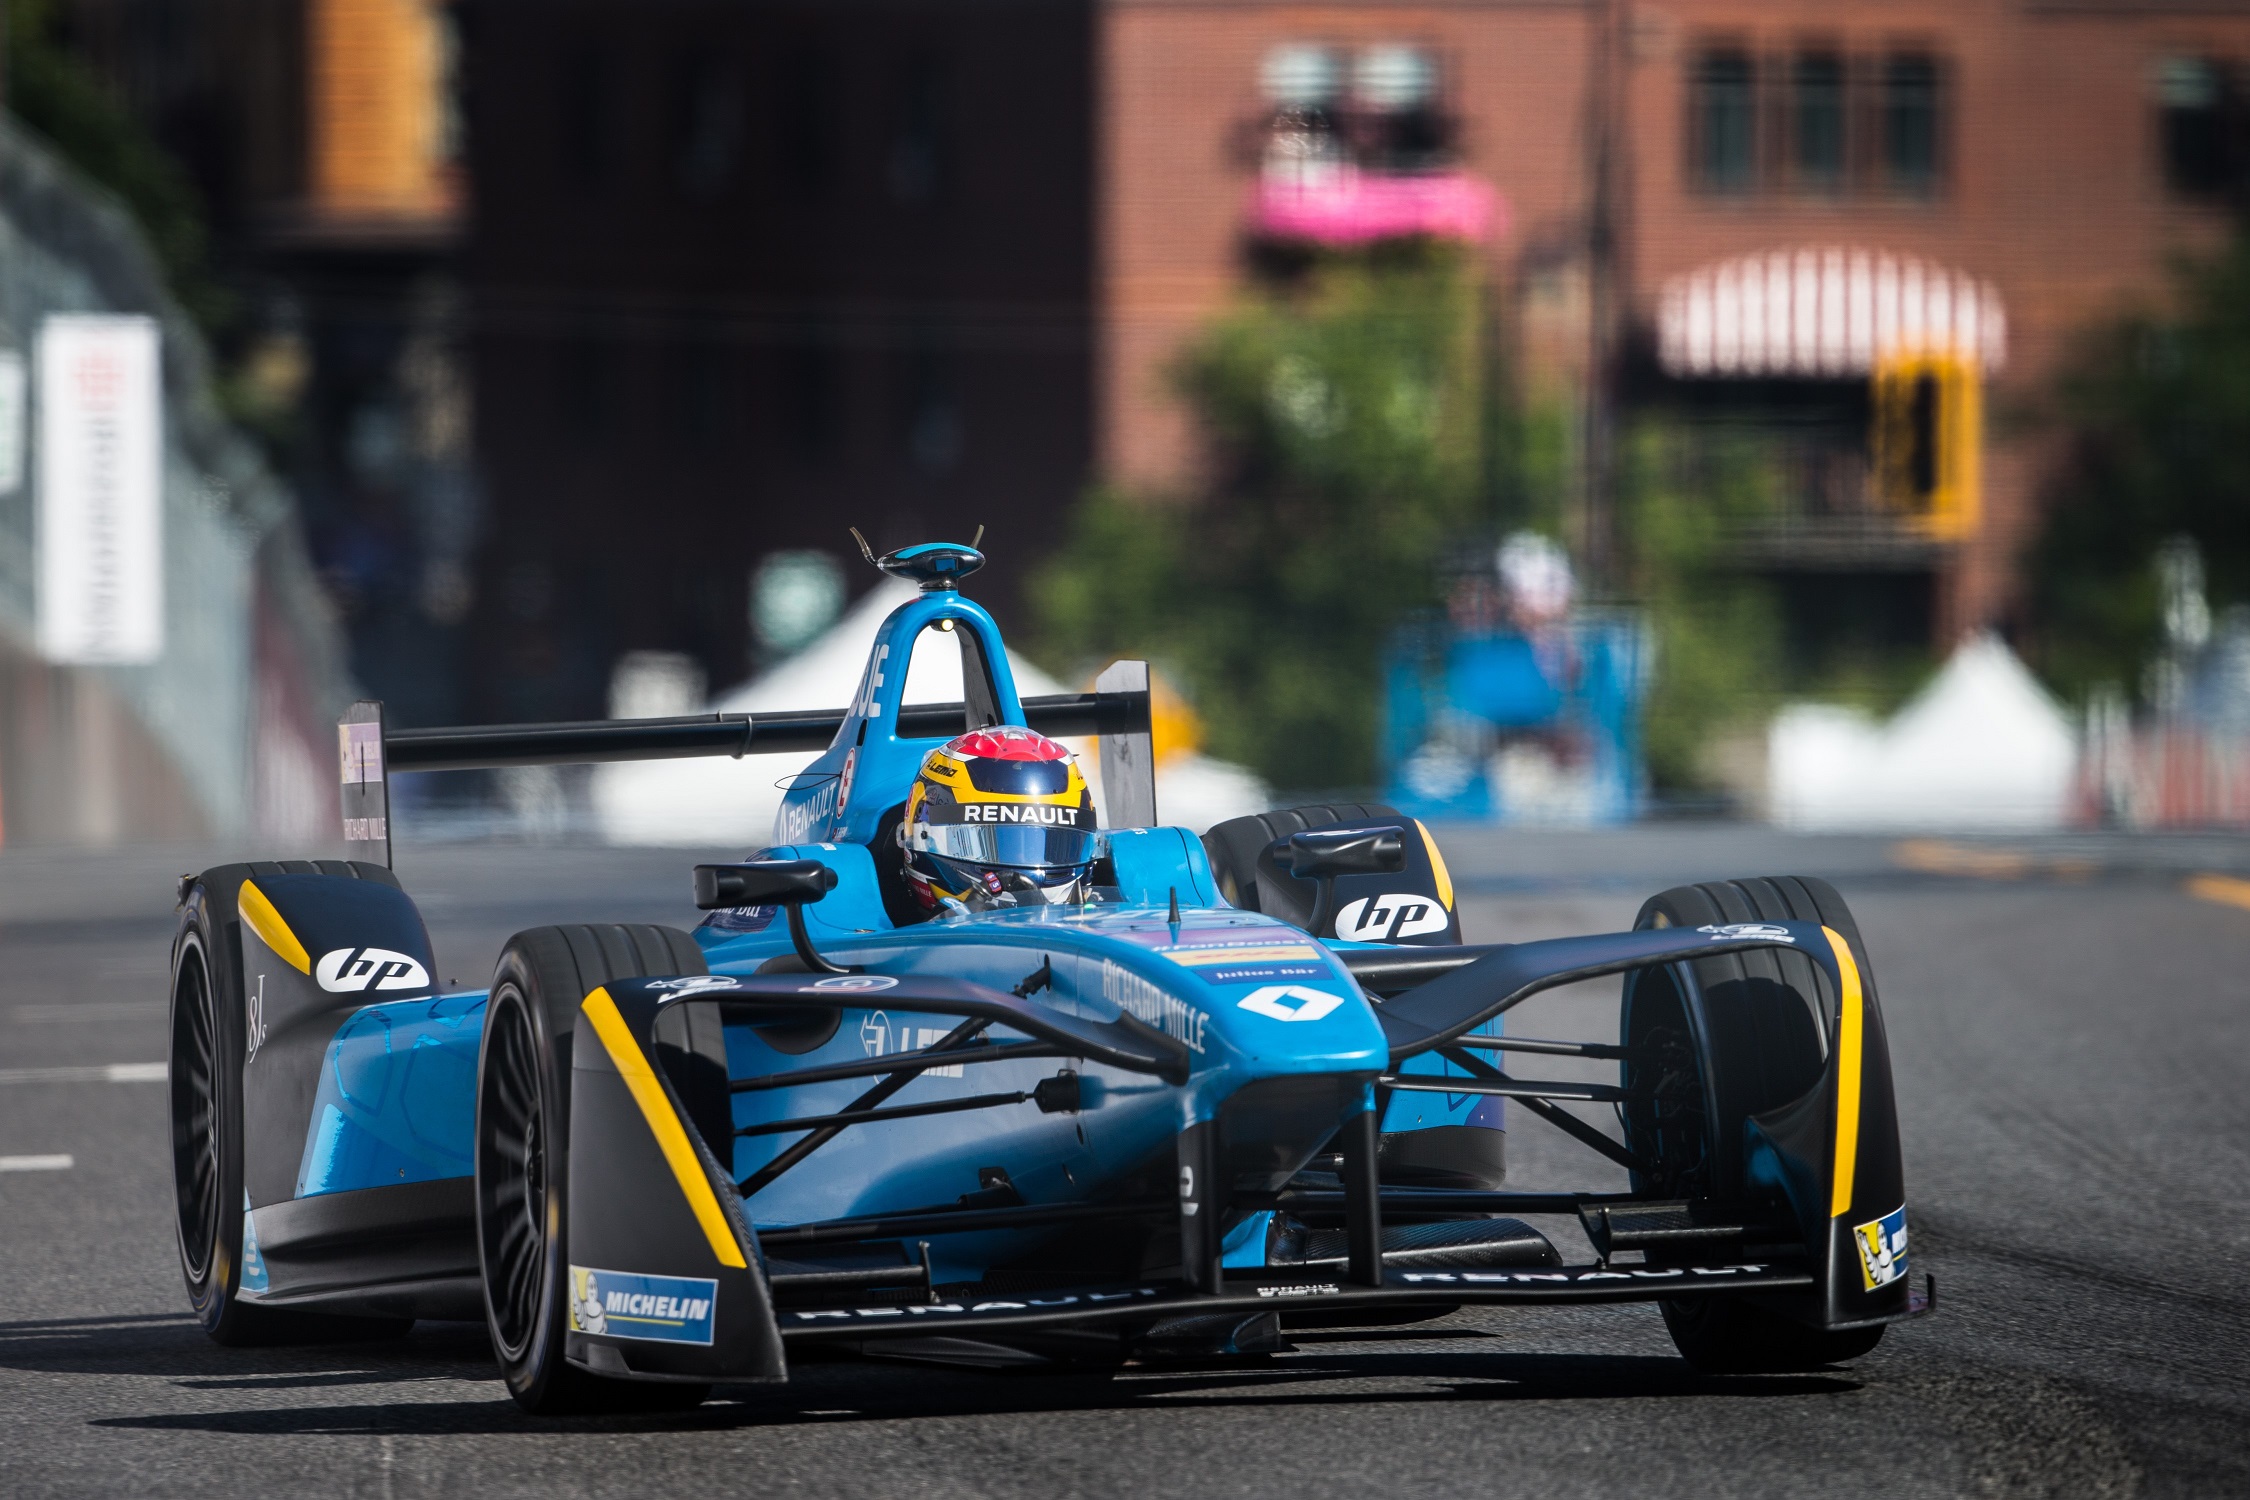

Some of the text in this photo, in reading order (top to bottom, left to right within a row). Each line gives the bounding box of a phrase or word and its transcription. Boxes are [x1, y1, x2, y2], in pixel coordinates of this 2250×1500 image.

[930, 762, 958, 777] LEMO
[788, 781, 837, 843] RENAULT
[964, 805, 1079, 826] RENAULT
[1355, 895, 1430, 940] hp
[335, 947, 414, 991] hp
[1103, 958, 1210, 1055] RICHARD MILLE
[1402, 1264, 1769, 1282] RENAULT
[605, 1291, 711, 1320] MICHELIN
[796, 1286, 1163, 1320] RENAULT
